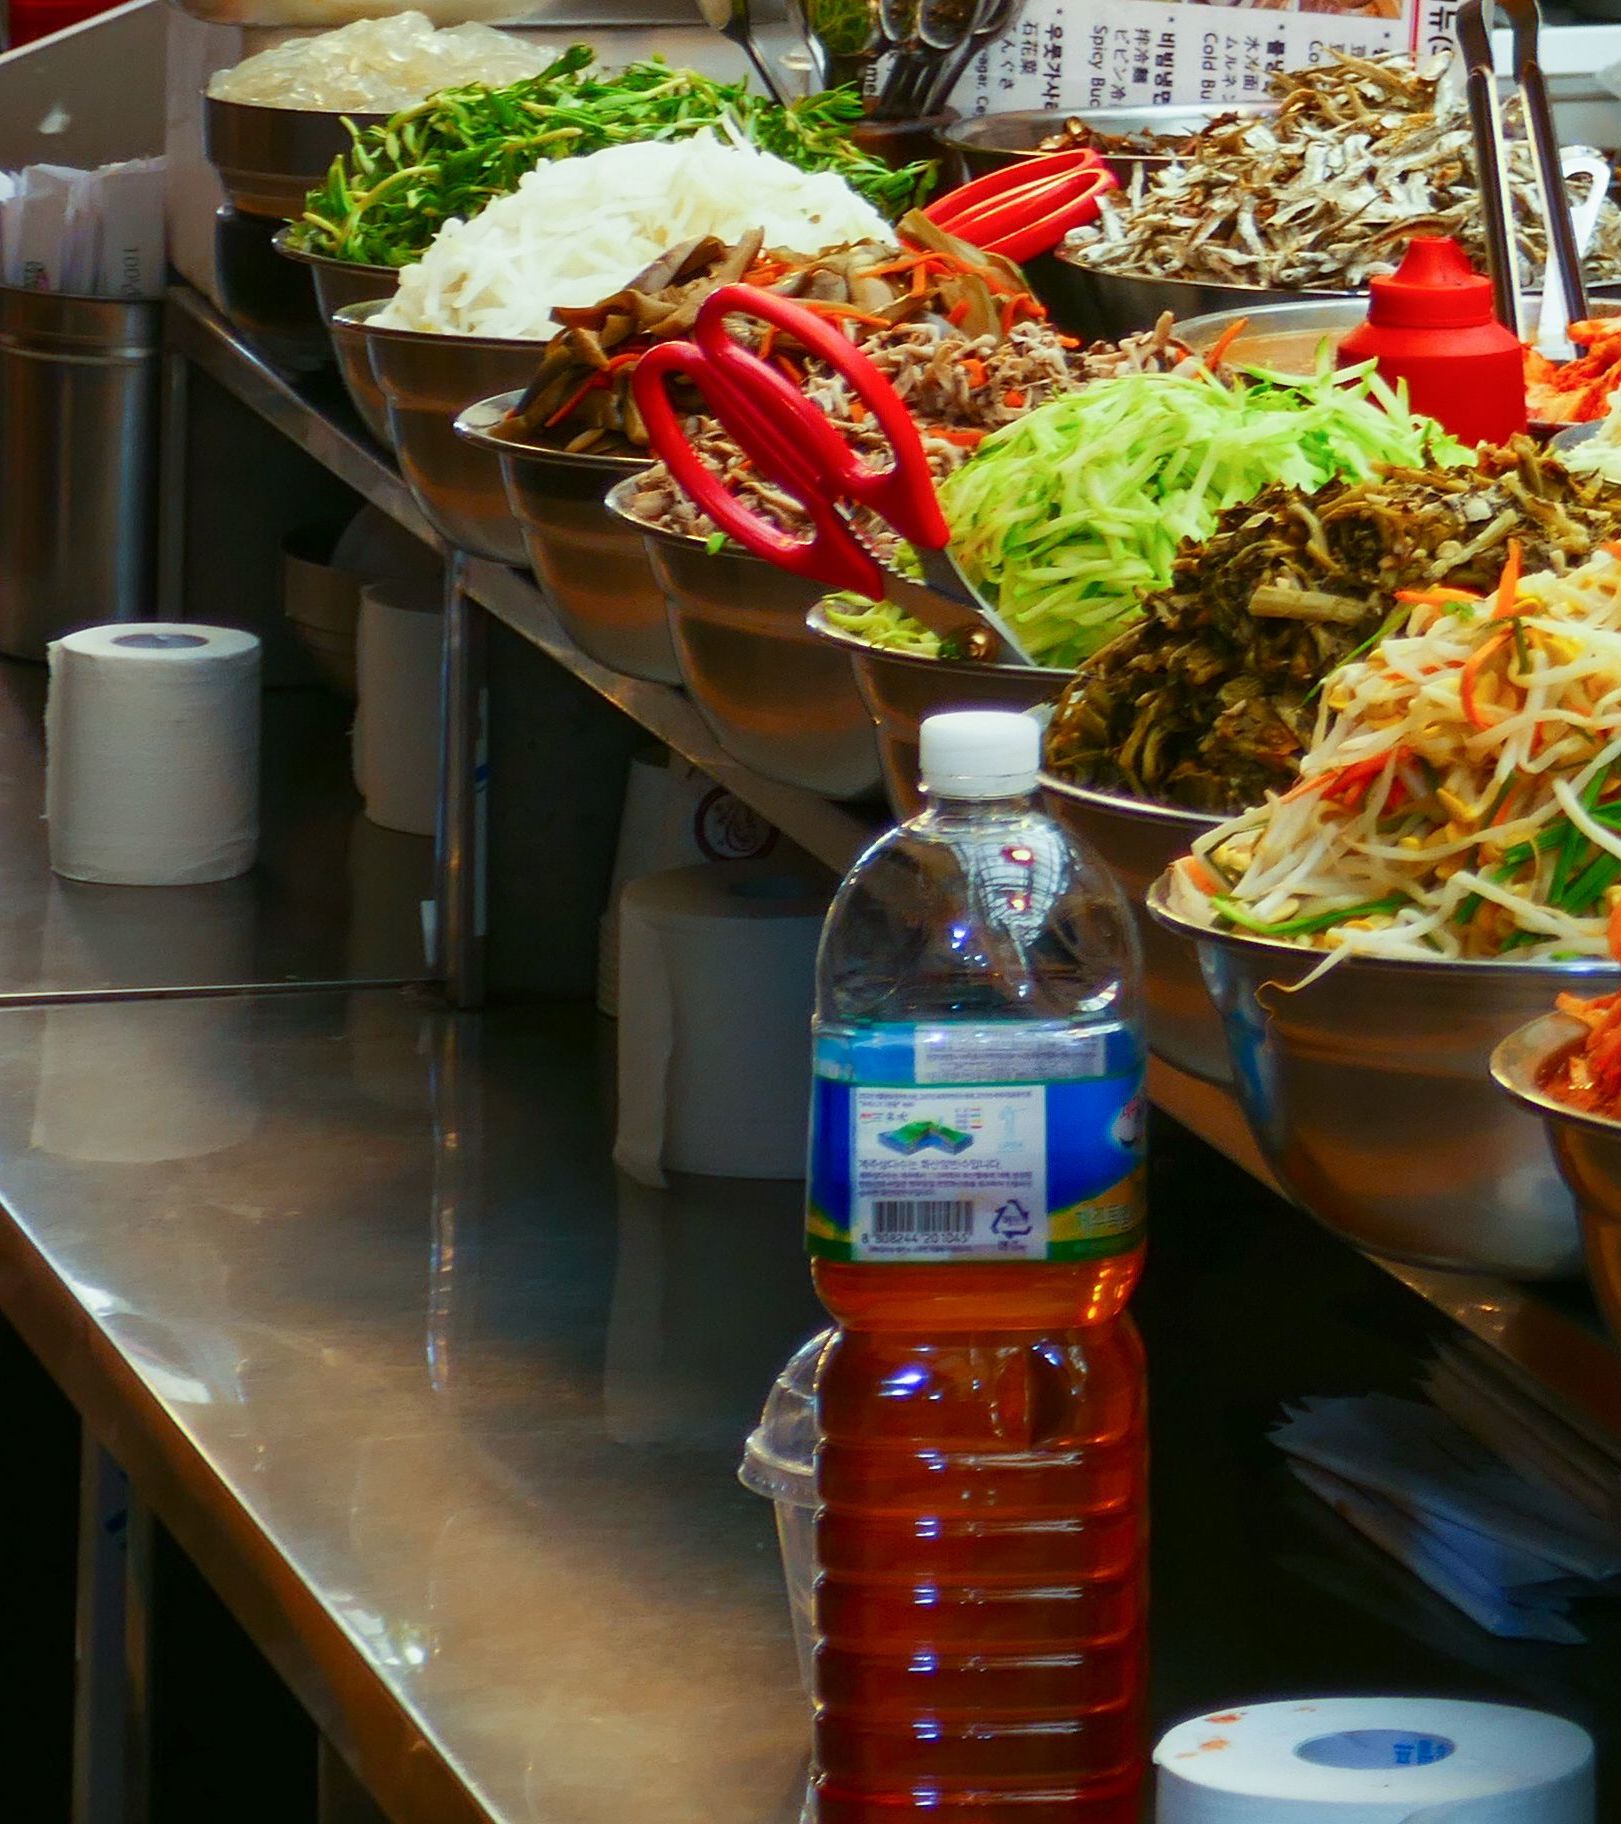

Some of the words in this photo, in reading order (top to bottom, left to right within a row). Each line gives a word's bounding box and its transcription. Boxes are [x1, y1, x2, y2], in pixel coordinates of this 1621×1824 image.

[1089, 25, 1108, 71] Spicy
[1203, 32, 1220, 70] Cold
[1089, 77, 1106, 108] Buc
[1200, 79, 1218, 101] Bu
